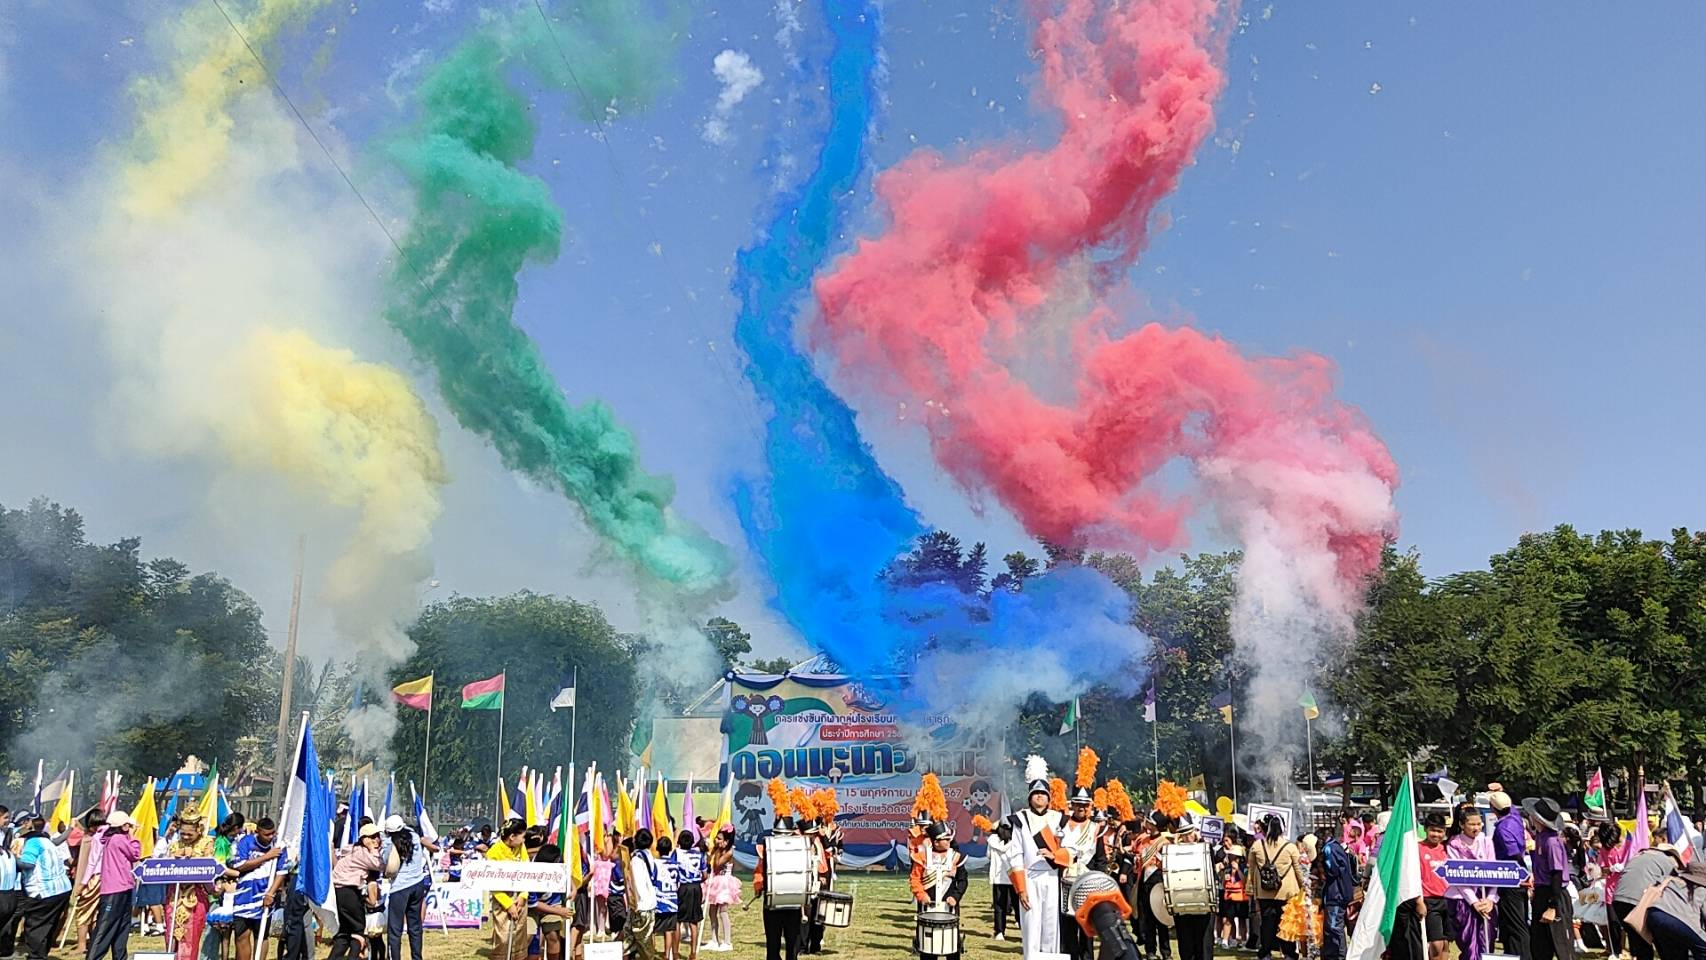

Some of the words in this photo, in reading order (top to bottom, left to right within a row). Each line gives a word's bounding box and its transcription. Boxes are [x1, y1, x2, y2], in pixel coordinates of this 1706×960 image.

[822, 728, 885, 738] ประจำปีการศึกษา
[845, 788, 857, 797] 15
[860, 787, 912, 799] พฤศจิกายน
[944, 788, 962, 797] 567
